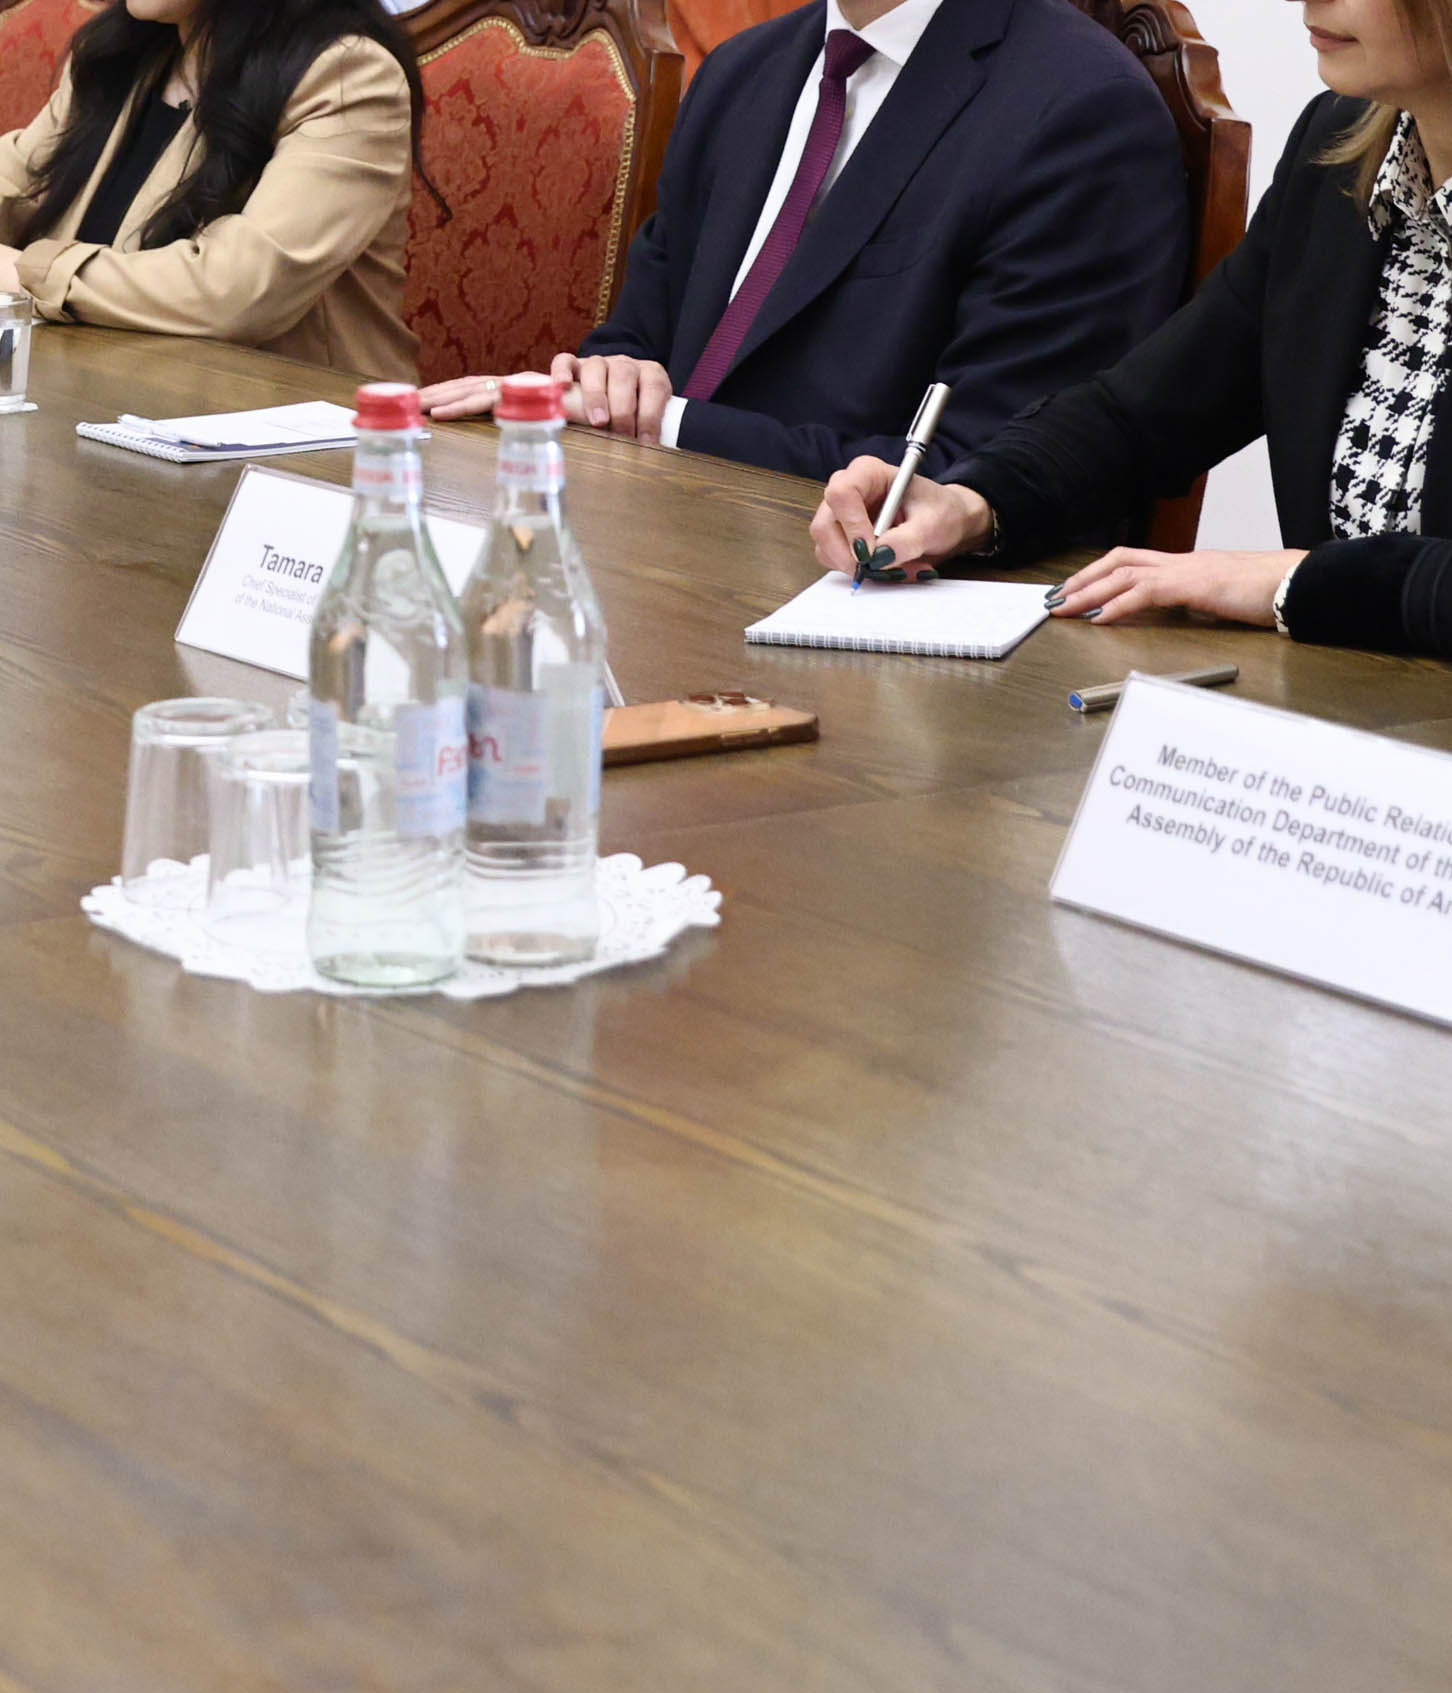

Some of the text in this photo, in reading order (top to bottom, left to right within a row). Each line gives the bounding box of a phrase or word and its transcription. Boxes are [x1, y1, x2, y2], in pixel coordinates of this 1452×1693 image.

[260, 544, 324, 584] Tamara
[1109, 765, 1267, 827] Communication
[1272, 808, 1400, 866] Department
[1405, 850, 1432, 873] of
[1156, 744, 1240, 785] Member
[1243, 770, 1269, 791] of
[1269, 775, 1302, 803] the
[1308, 785, 1378, 823] Public
[1126, 803, 1226, 854] Assembly
[1231, 835, 1257, 856] of
[1257, 842, 1291, 868] the
[1297, 851, 1394, 900] Republic
[1400, 885, 1428, 906] of
